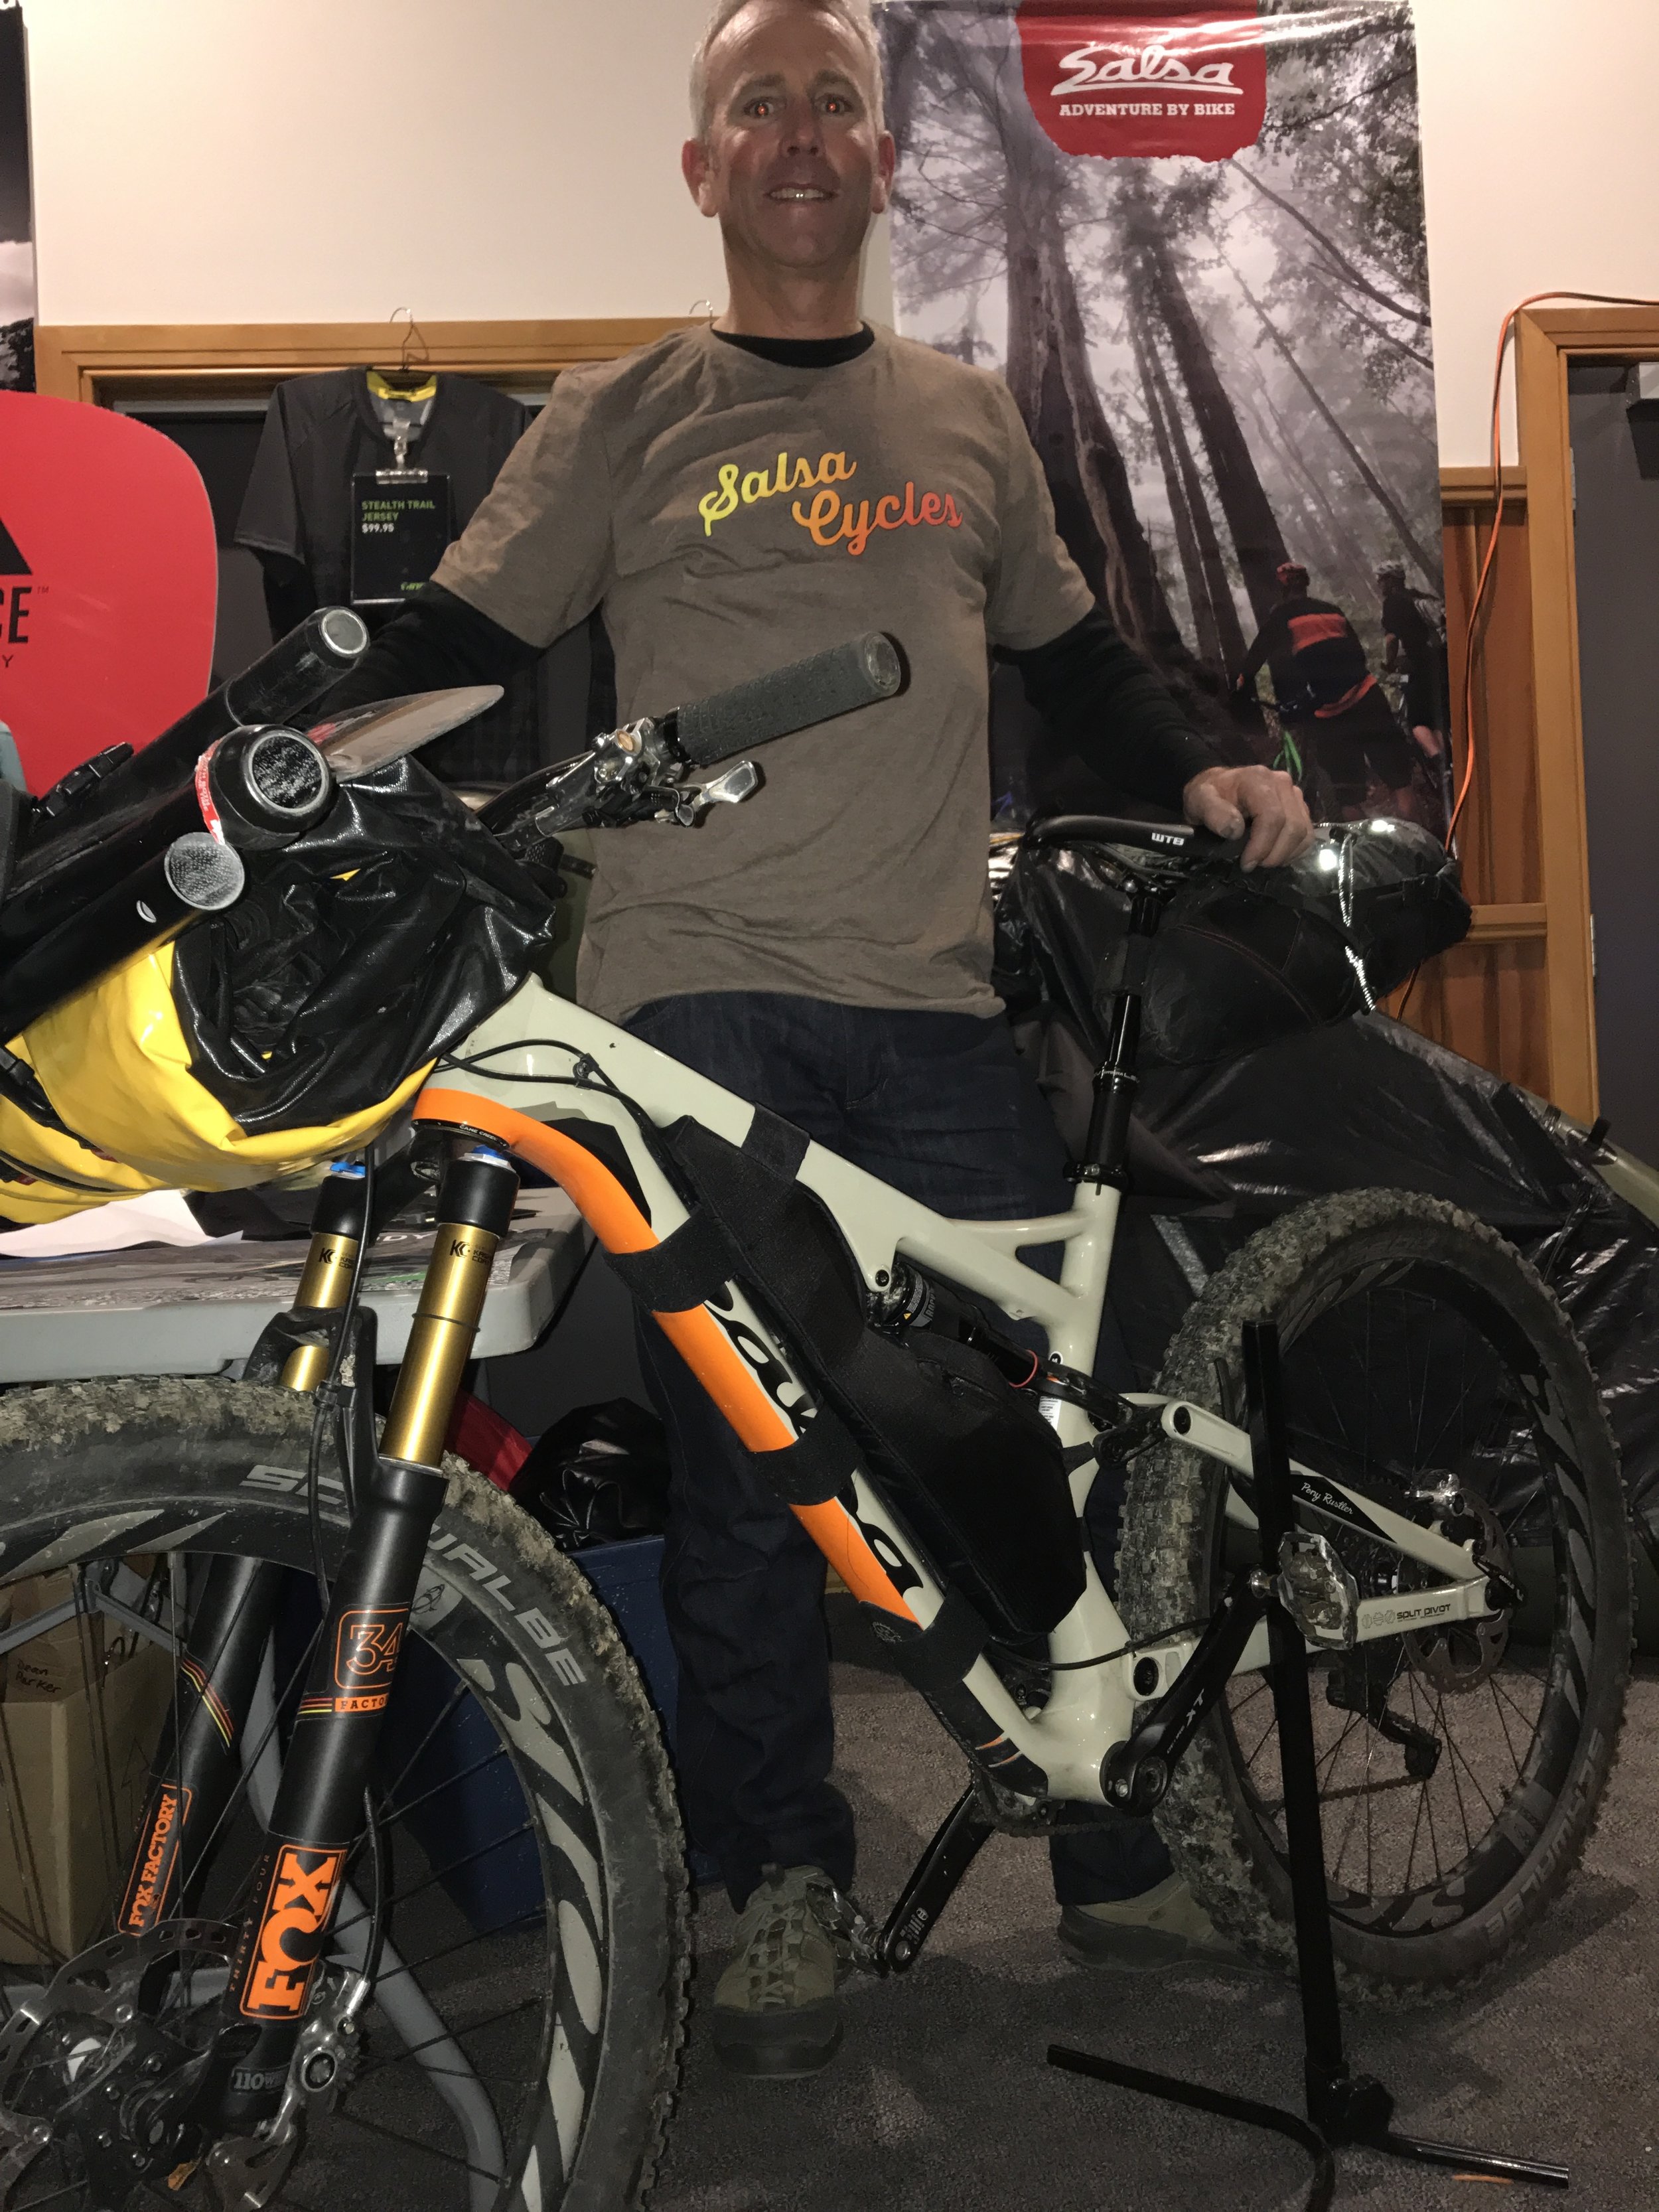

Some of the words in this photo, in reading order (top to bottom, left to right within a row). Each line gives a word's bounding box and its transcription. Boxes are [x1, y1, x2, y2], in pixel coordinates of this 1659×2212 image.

[1050, 44, 1244, 96] Salsa
[1059, 103, 1162, 116] ADVENTURE
[1167, 103, 1189, 115] BY
[1193, 103, 1235, 115] BIKE
[698, 451, 857, 536] Salsa
[362, 500, 405, 510] STEALTH
[407, 500, 435, 510] TRAIL
[362, 512, 399, 522] JERSEY
[792, 481, 964, 555] Cycles
[362, 523, 395, 534] $99.95
[1151, 832, 1185, 846] WTB
[459, 1124, 478, 1134] CANE
[1301, 1482, 1320, 1503] Pony
[1323, 1492, 1354, 1514] Rustler
[1396, 1609, 1422, 1621] SPLIT
[1423, 1603, 1451, 1619] PIVOT
[15, 1670, 62, 1693] Parker
[129, 1884, 153, 1927] FOX
[141, 1794, 177, 1883] FACTORY
[248, 1852, 337, 2012] FOX
